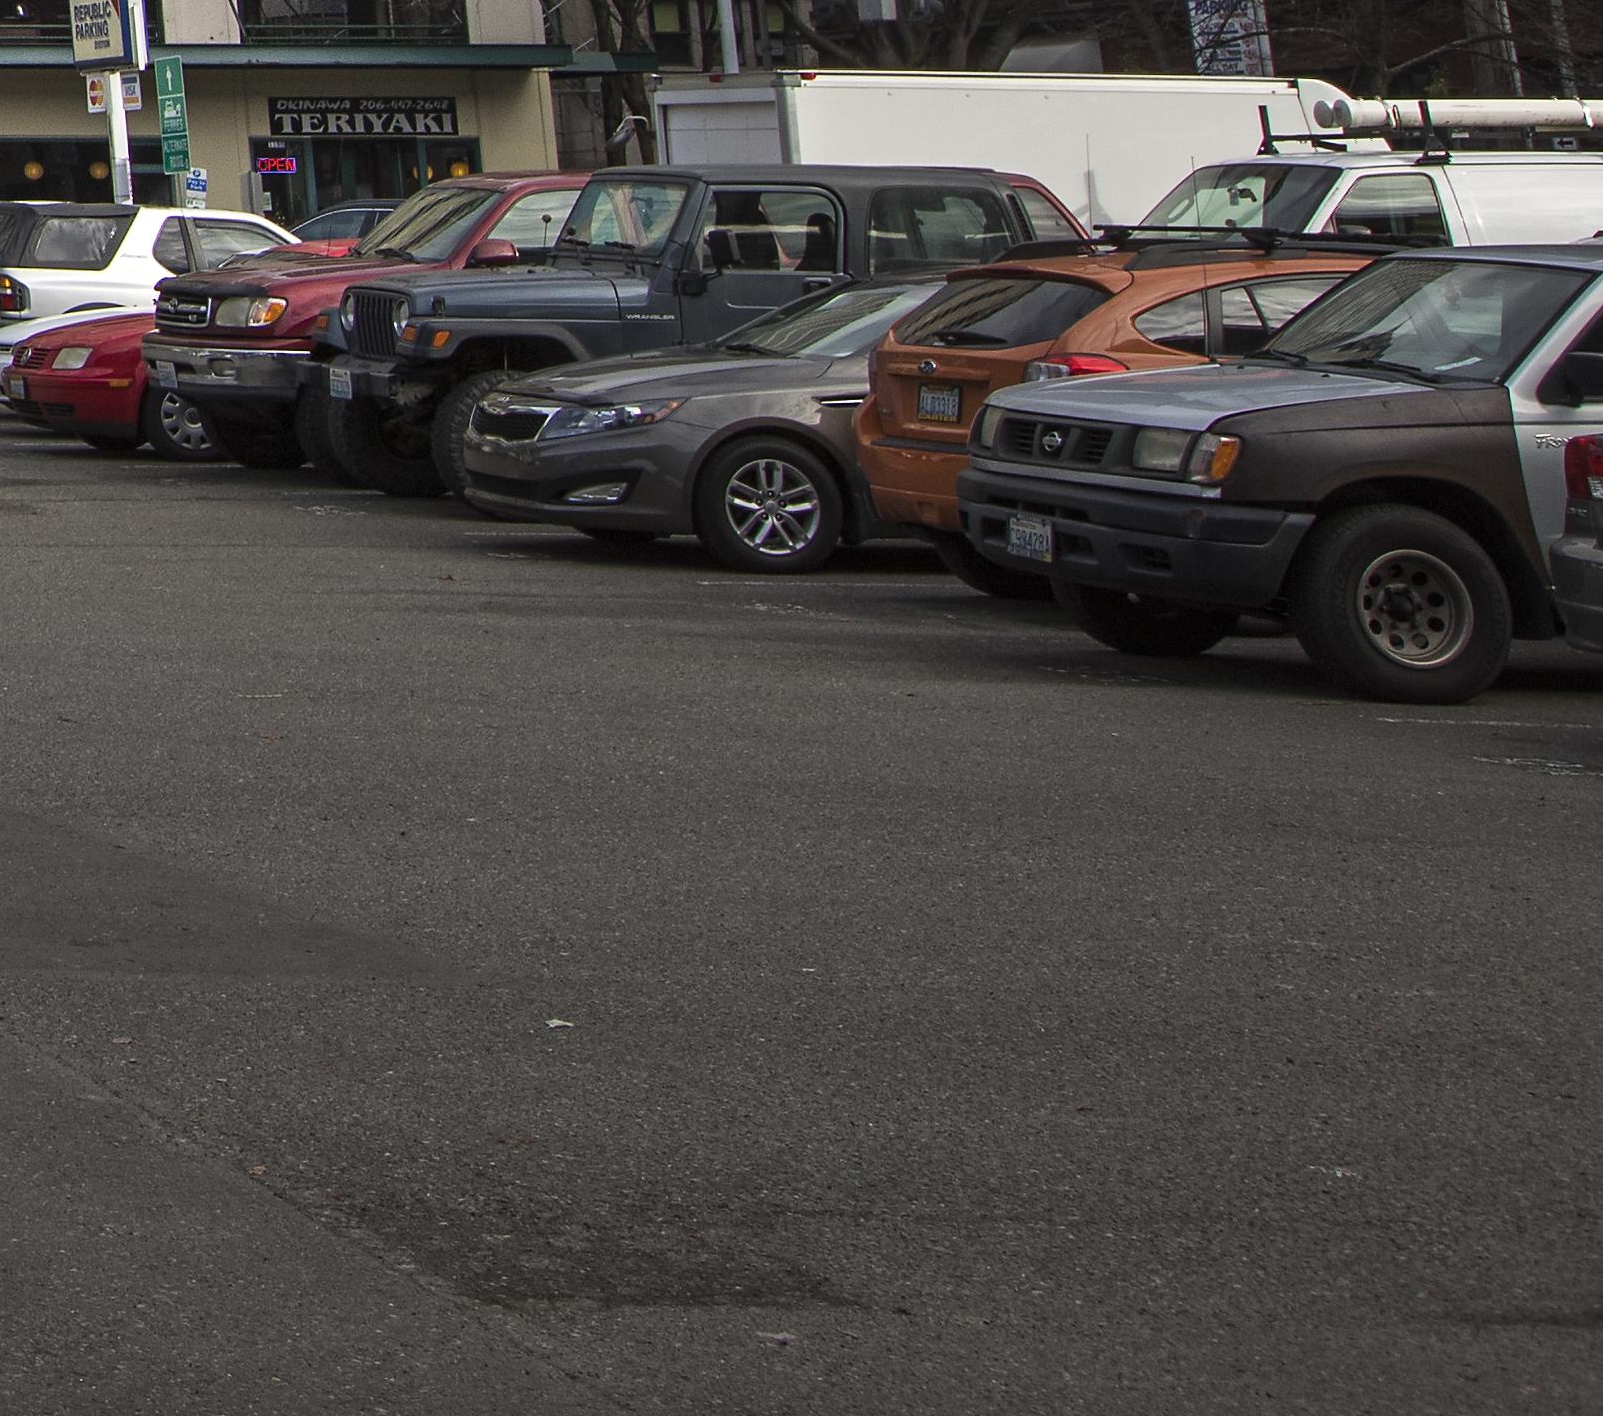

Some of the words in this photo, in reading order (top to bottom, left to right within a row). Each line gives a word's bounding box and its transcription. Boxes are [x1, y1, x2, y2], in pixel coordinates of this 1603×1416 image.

[74, 0, 111, 22] REPUBLIC
[75, 21, 109, 41] PARKING
[125, 86, 136, 96] VISA
[277, 100, 351, 110] OKINAWA
[275, 113, 454, 133] TERIYAKI
[258, 158, 295, 171] OPEN
